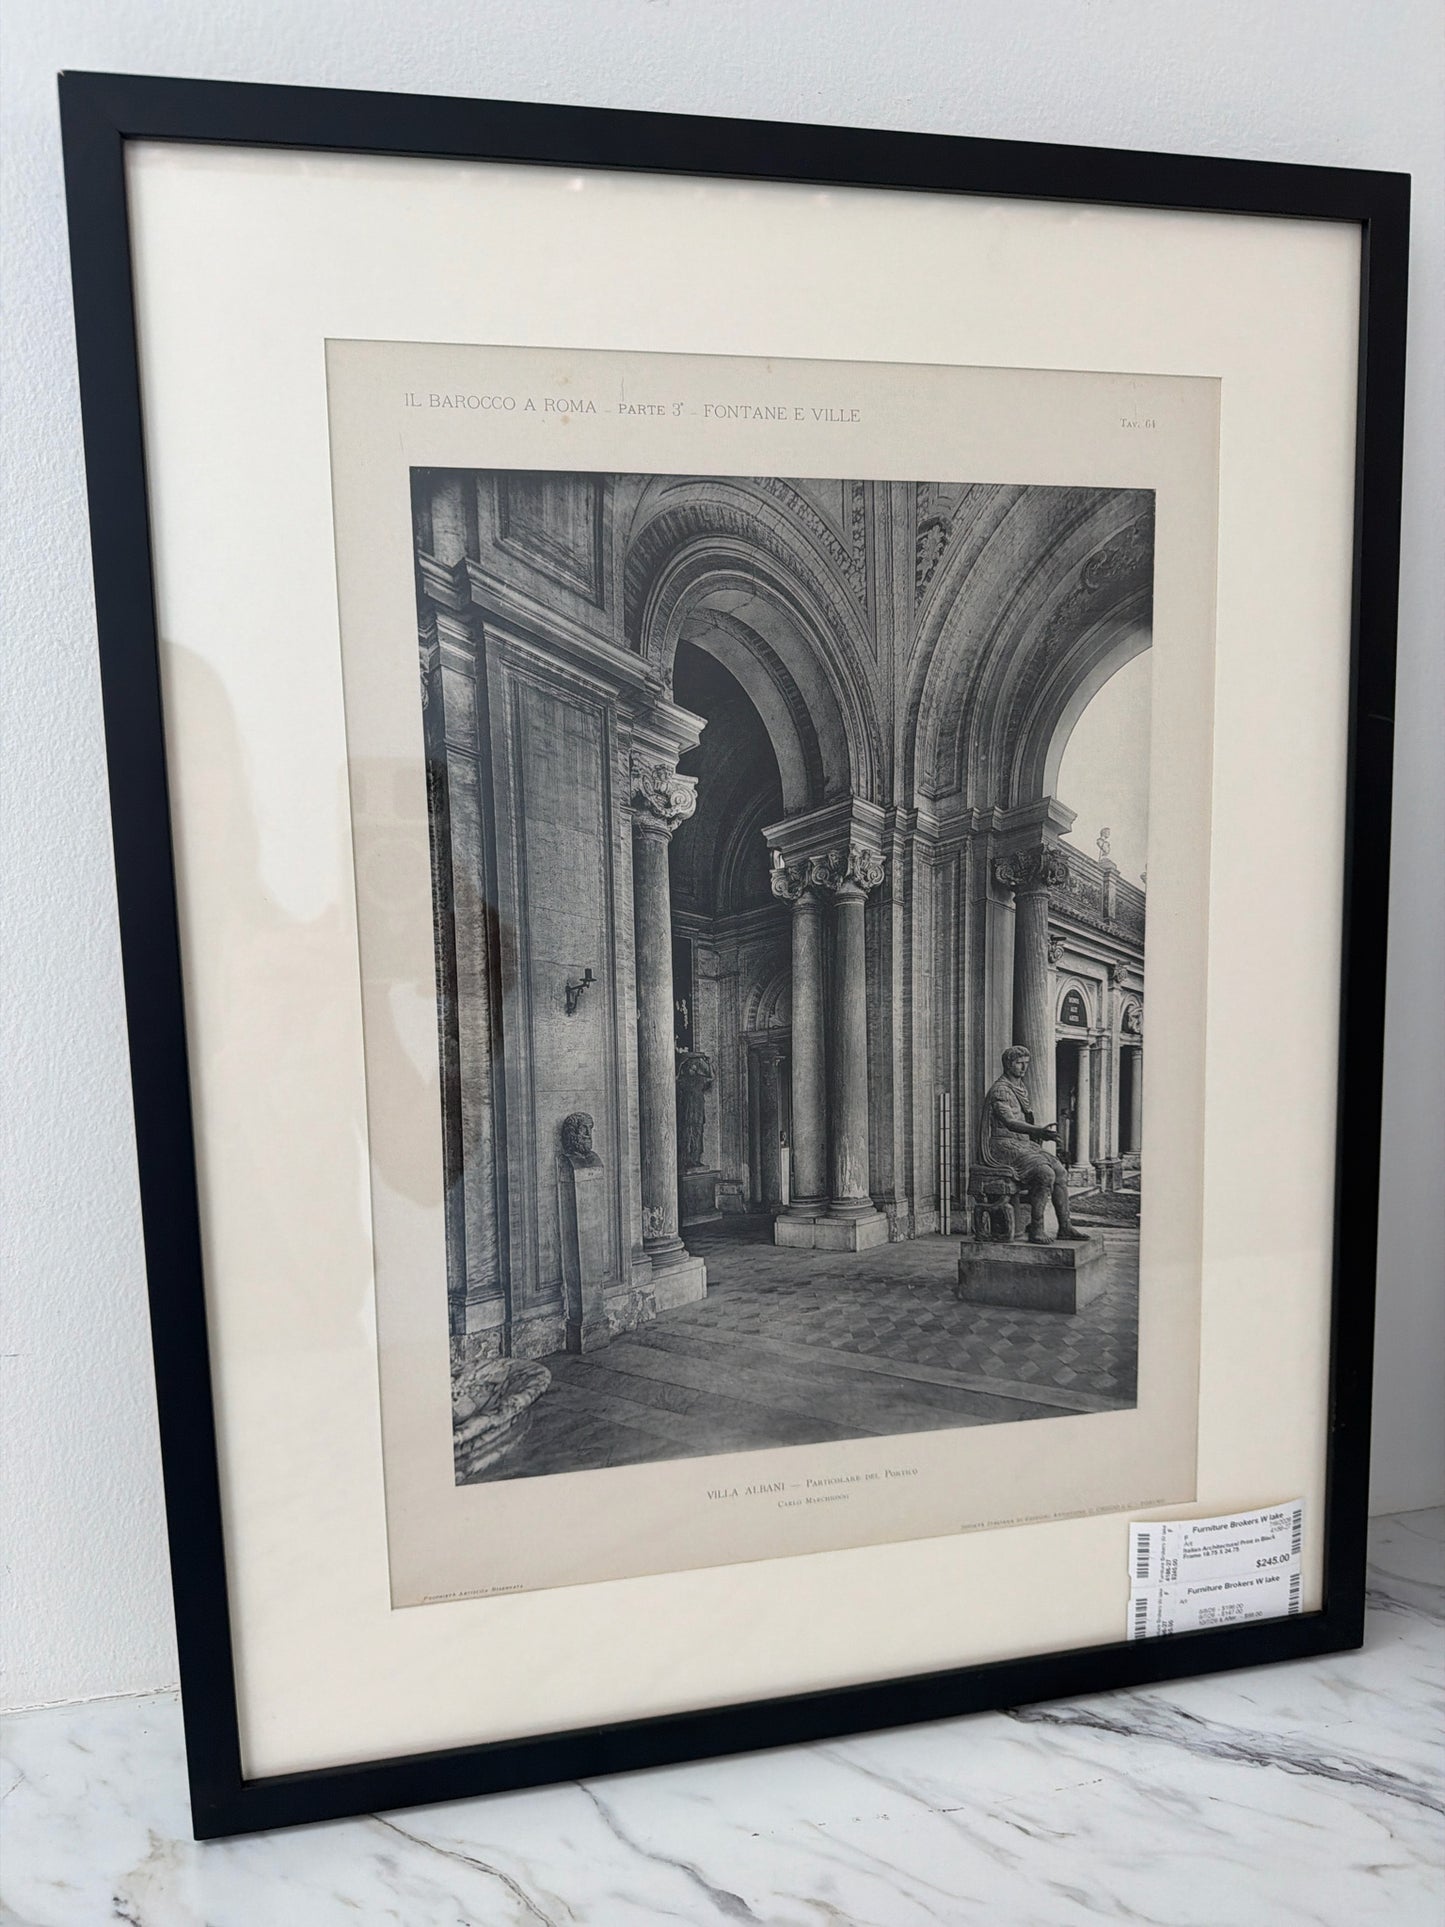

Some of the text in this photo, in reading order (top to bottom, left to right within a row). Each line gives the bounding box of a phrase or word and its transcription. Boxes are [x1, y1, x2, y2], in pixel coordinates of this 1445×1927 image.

[404, 393, 422, 406] IL
[429, 394, 516, 410] BAROCCO
[524, 398, 536, 411] A
[544, 398, 597, 413] ROMA
[704, 404, 787, 420] FONTANE
[794, 407, 805, 421] E
[811, 408, 861, 423] VILLE
[707, 1488, 738, 1500] VILLA
[745, 1482, 785, 1495] ALBANI
[1192, 1523, 1228, 1533] Furniture
[1230, 1519, 1259, 1528] Brokers
[1260, 1514, 1268, 1522] W
[1256, 1553, 1290, 1568] $245.00
[1187, 1585, 1223, 1595] Furniture
[1224, 1580, 1254, 1590] Brokers
[1265, 1576, 1280, 1584] lake
